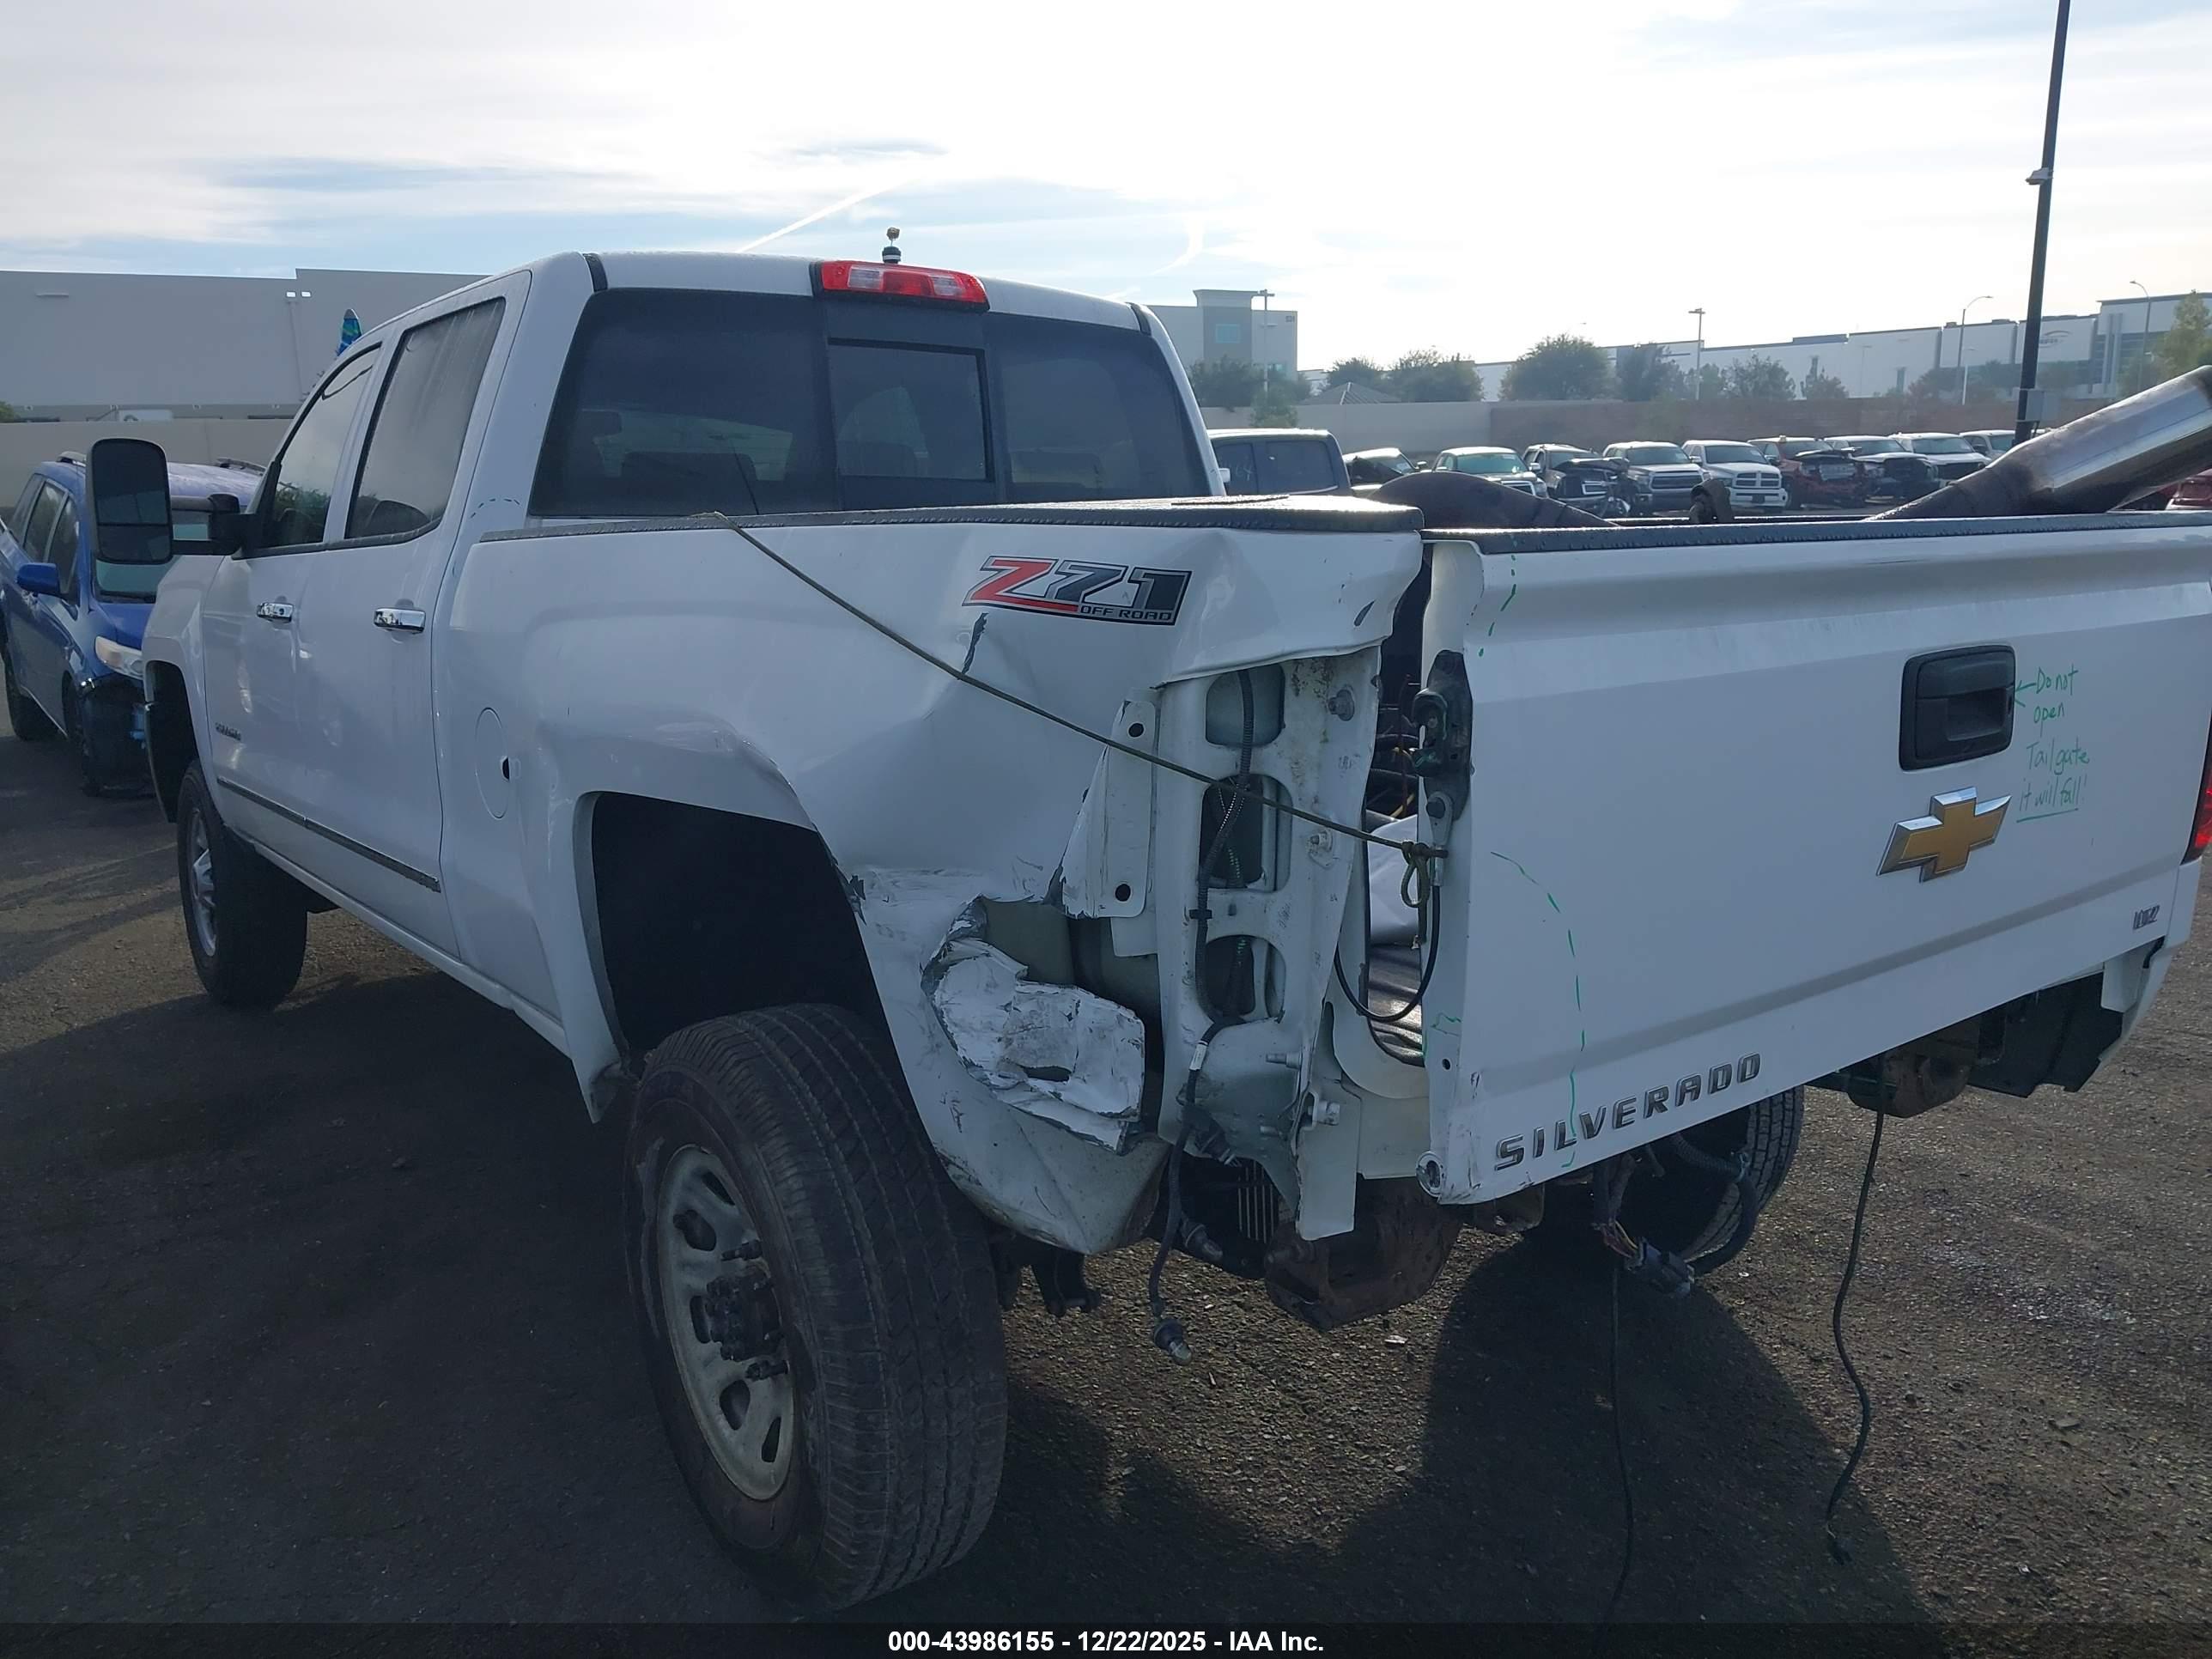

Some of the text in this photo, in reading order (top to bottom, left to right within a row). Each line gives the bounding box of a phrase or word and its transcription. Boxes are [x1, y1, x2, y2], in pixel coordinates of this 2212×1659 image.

[962, 556, 1193, 613] Z71
[1080, 605, 1174, 622] OFF ROAD
[2035, 663, 2079, 696] Do not
[2033, 702, 2065, 738] open
[2027, 737, 2091, 775] Tailgate
[2019, 778, 2033, 811] it
[2035, 776, 2059, 806] will
[1494, 1052, 1761, 1171] SILVERADO
